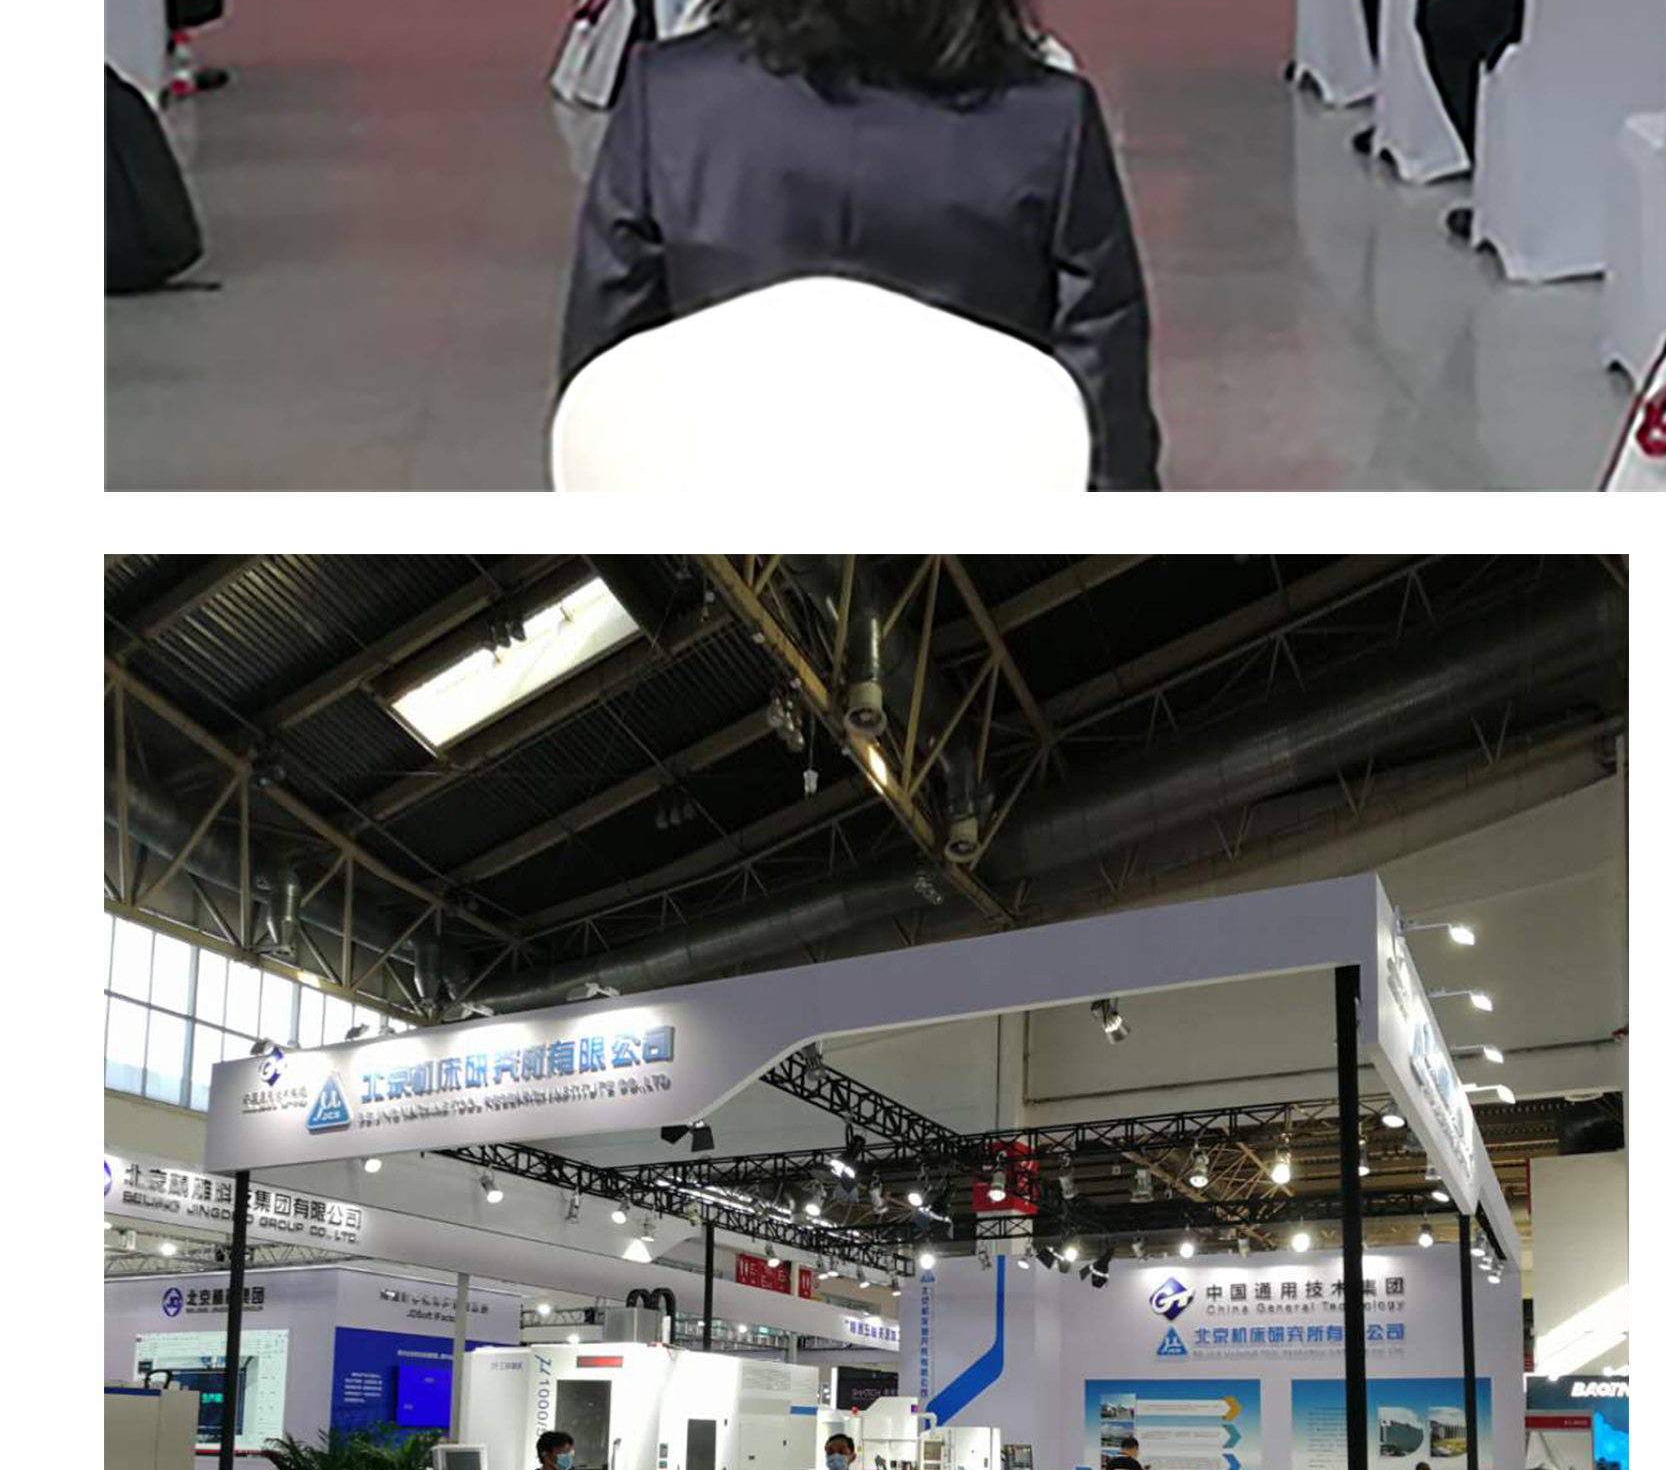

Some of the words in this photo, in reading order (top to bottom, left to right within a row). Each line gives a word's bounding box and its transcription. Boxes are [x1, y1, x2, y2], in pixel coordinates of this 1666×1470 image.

[124, 1163, 363, 1230] 北京精雕科集团有限公司
[186, 1203, 254, 1225] JINGDO
[1206, 1277, 1405, 1302] 中国通用技术集团
[1321, 1299, 1405, 1314] Tecology
[1193, 1323, 1405, 1346] 北京机床研究所有公司
